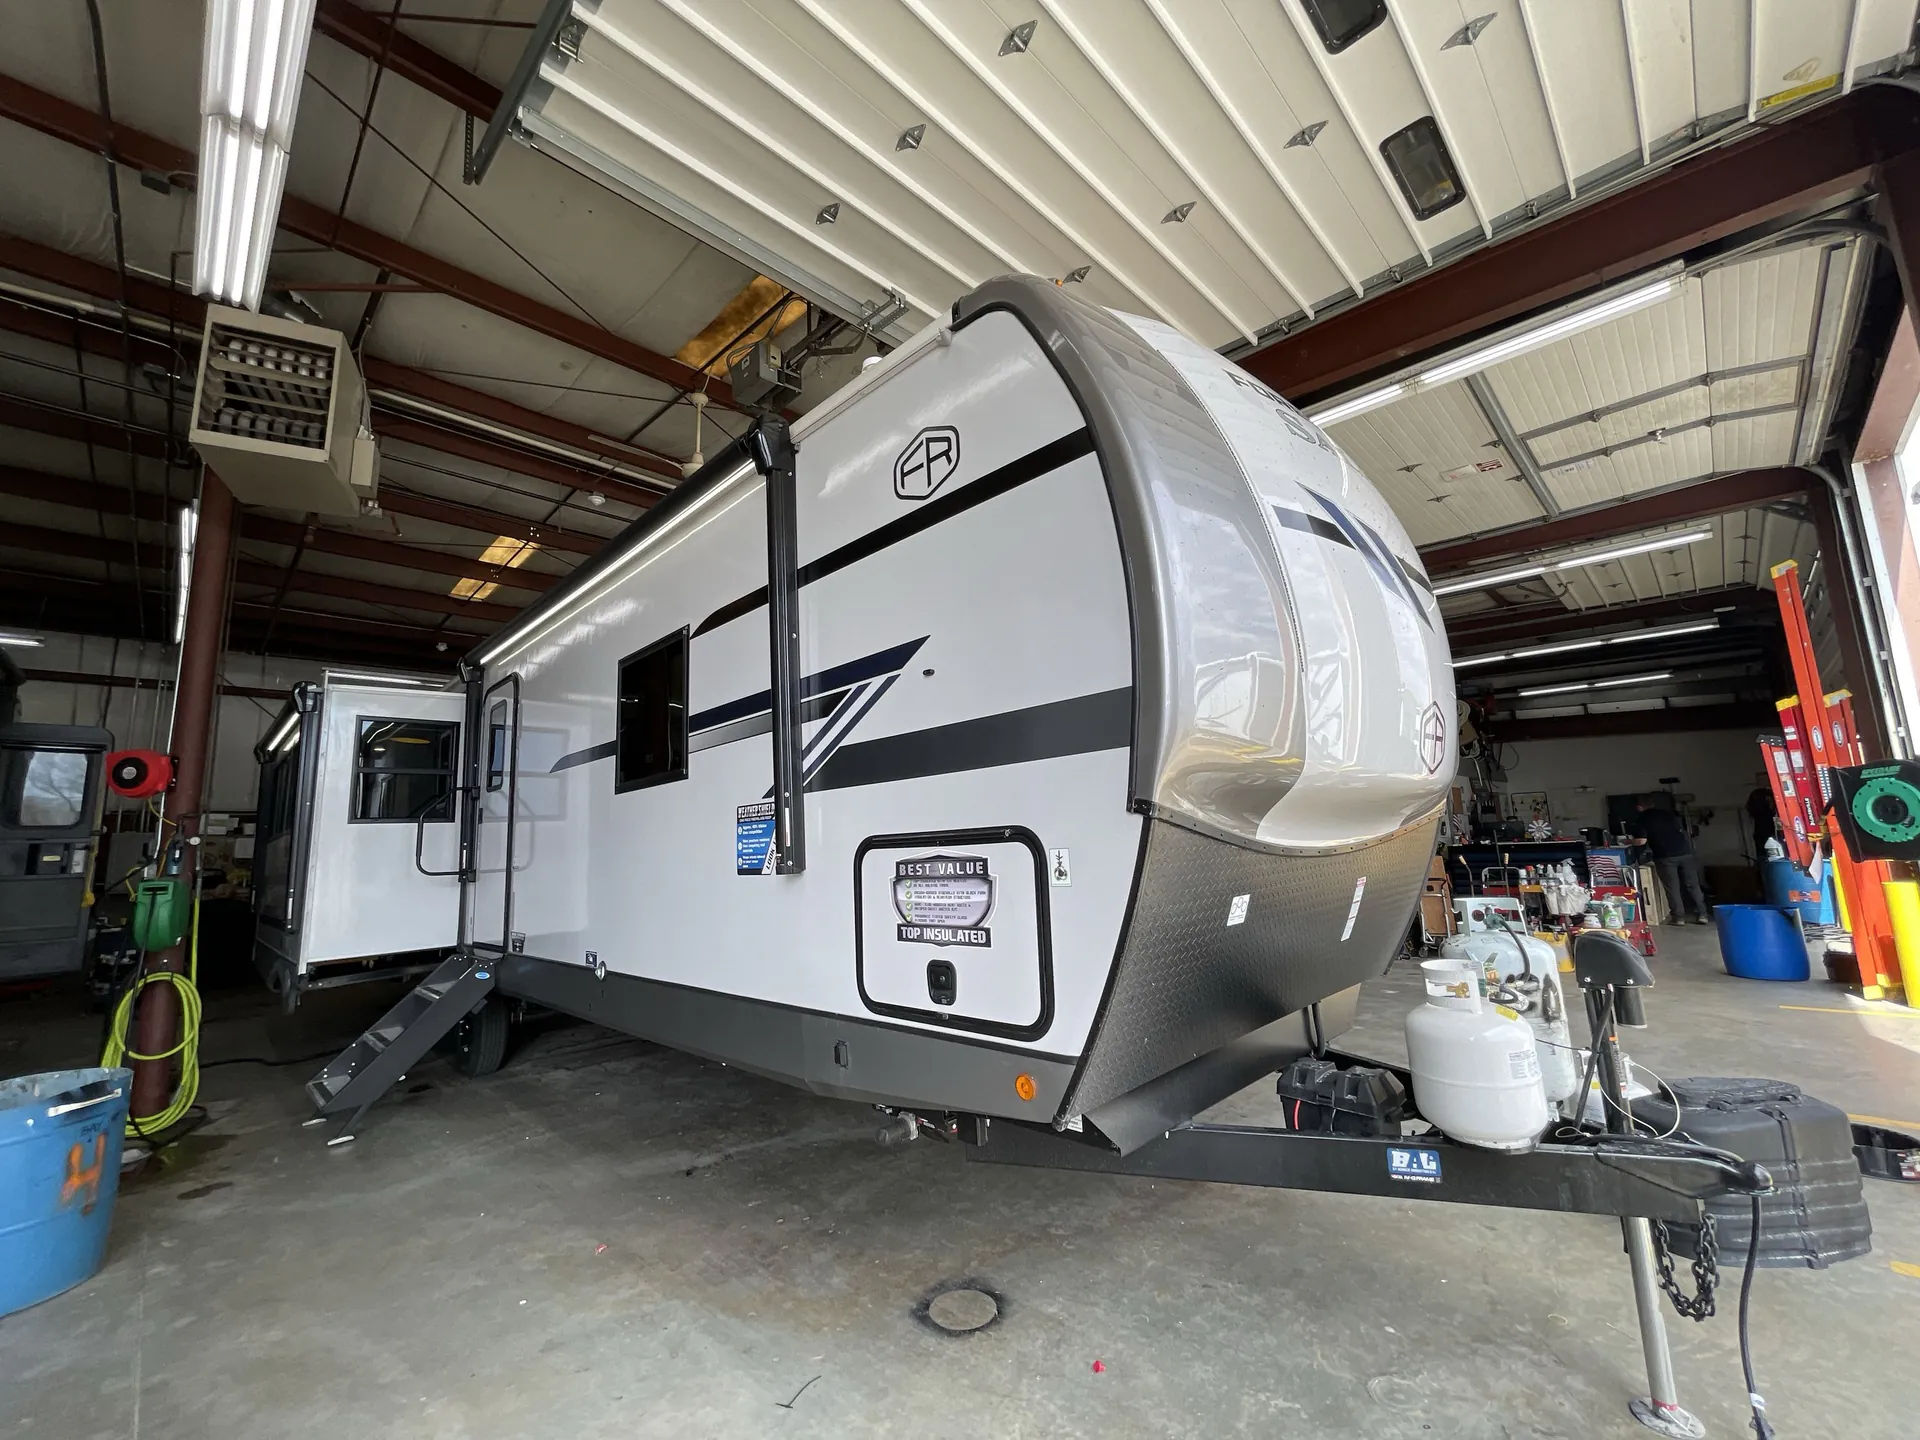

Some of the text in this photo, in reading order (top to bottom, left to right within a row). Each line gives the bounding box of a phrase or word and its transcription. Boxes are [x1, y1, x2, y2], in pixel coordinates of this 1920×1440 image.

[899, 861, 984, 876] BEST VALUE
[901, 926, 987, 944] TOP INSULATED
